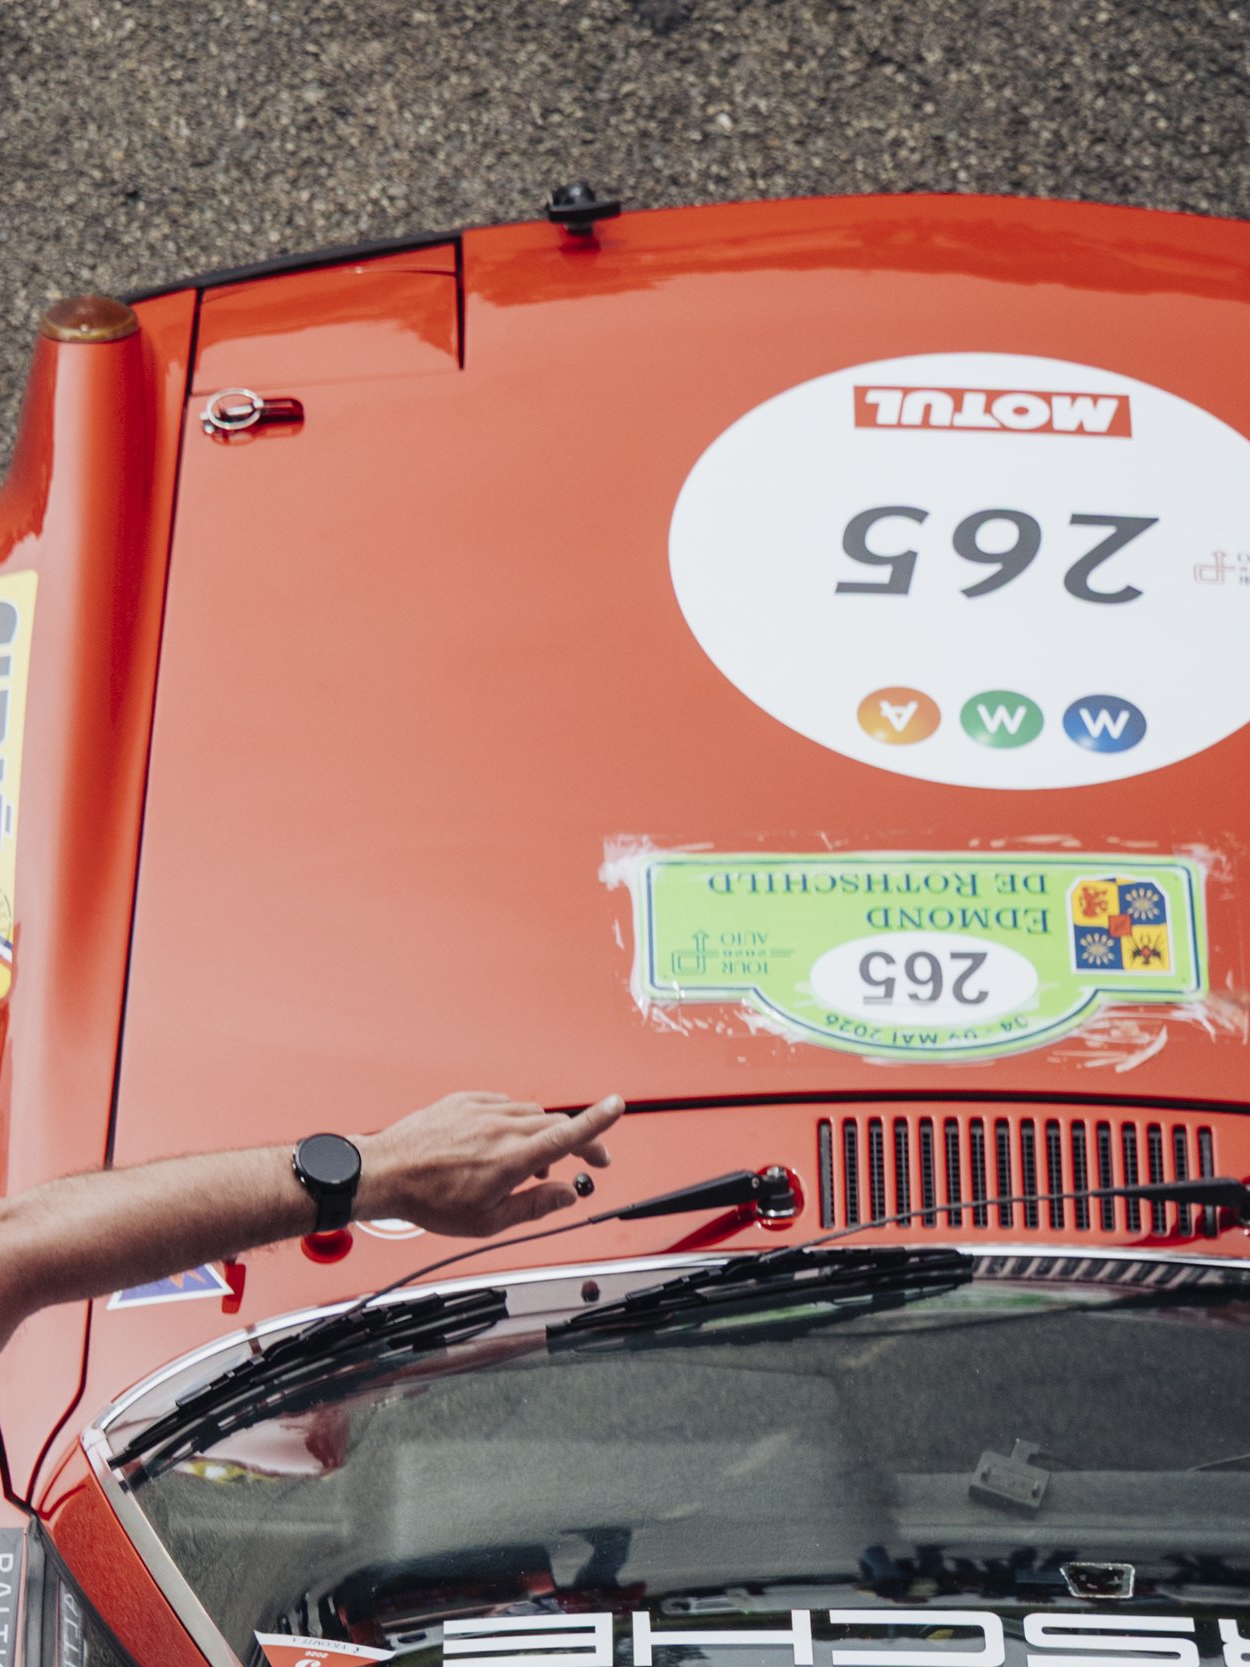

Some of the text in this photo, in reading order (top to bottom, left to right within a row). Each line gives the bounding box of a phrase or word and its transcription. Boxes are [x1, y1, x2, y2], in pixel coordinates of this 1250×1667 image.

[865, 388, 1119, 432] MOTUL
[835, 505, 1160, 605] 265
[708, 871, 1048, 897] DE ROTHSCHILD
[866, 907, 1050, 934] EDMOND
[858, 950, 989, 1006] 265
[892, 1031, 938, 1045] MAI
